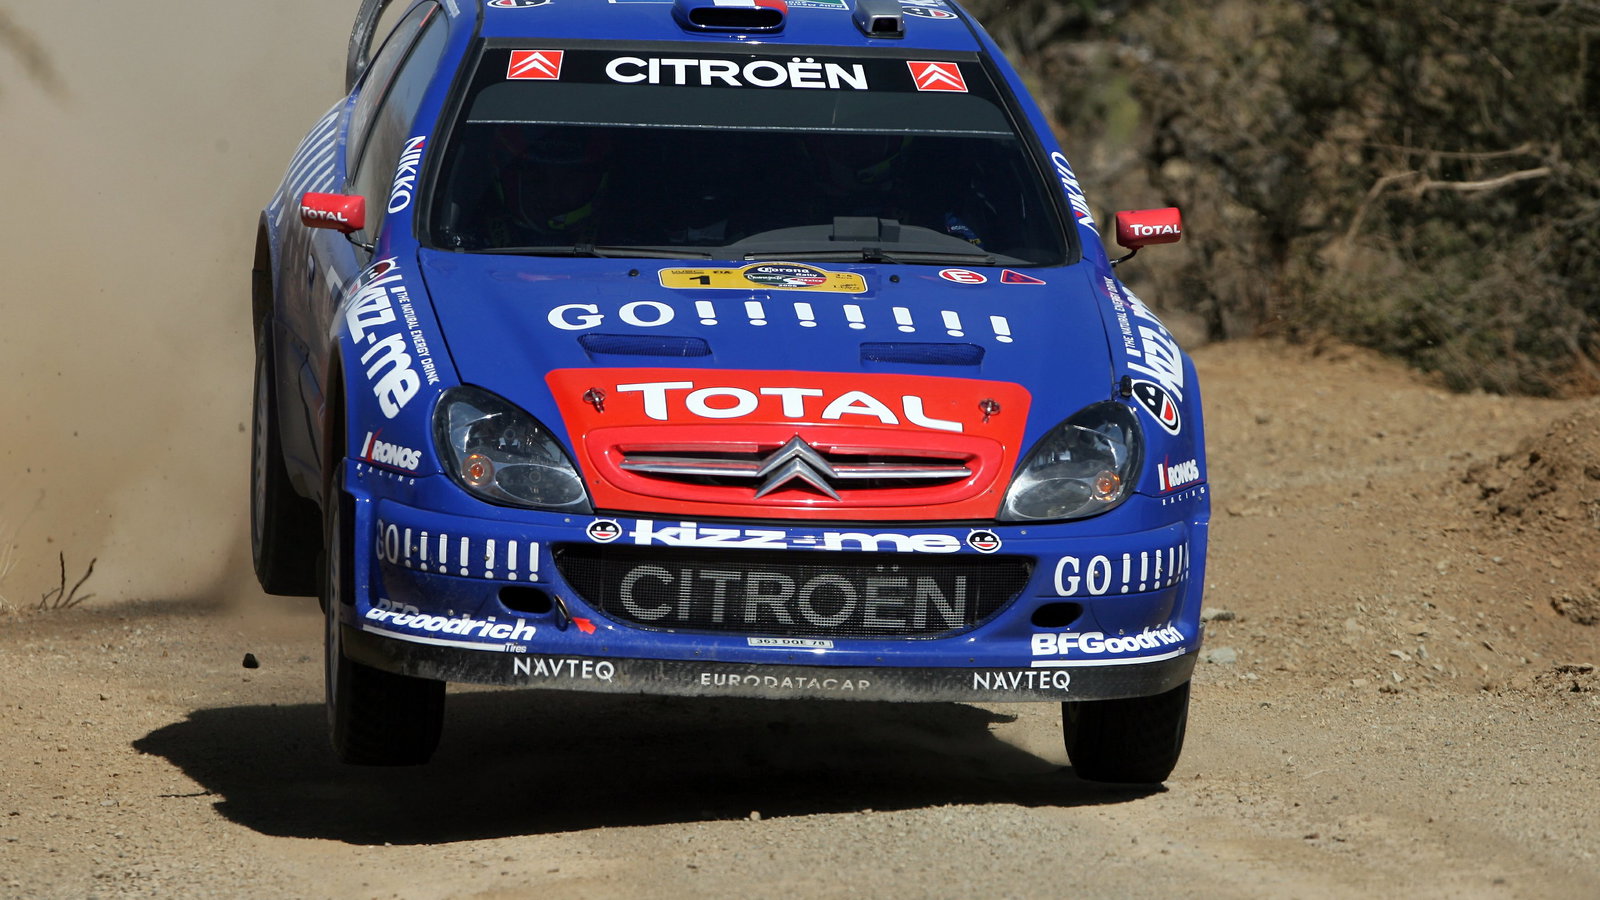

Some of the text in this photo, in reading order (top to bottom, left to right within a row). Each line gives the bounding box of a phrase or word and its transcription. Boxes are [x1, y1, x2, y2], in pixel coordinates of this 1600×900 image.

[605, 56, 868, 90] CITROËN
[388, 135, 426, 214] NIKKO
[1051, 151, 1099, 237] NIKKO
[302, 206, 348, 222] TOTAL
[1130, 223, 1180, 236] TOTAL
[689, 275, 711, 285] 1
[397, 291, 440, 386] THE NATURAL ENERGY DRINK
[616, 381, 964, 432] TOTAL
[356, 463, 415, 486] RACING
[620, 564, 967, 630] CITROËN
[365, 598, 537, 641] BFGoodrich
[504, 642, 527, 653] Tires
[1031, 621, 1185, 655] BFGoodrich
[513, 656, 615, 683] NAVTEQ
[701, 673, 871, 691] EURODATACAR
[973, 670, 1071, 692] NAVTEQ
